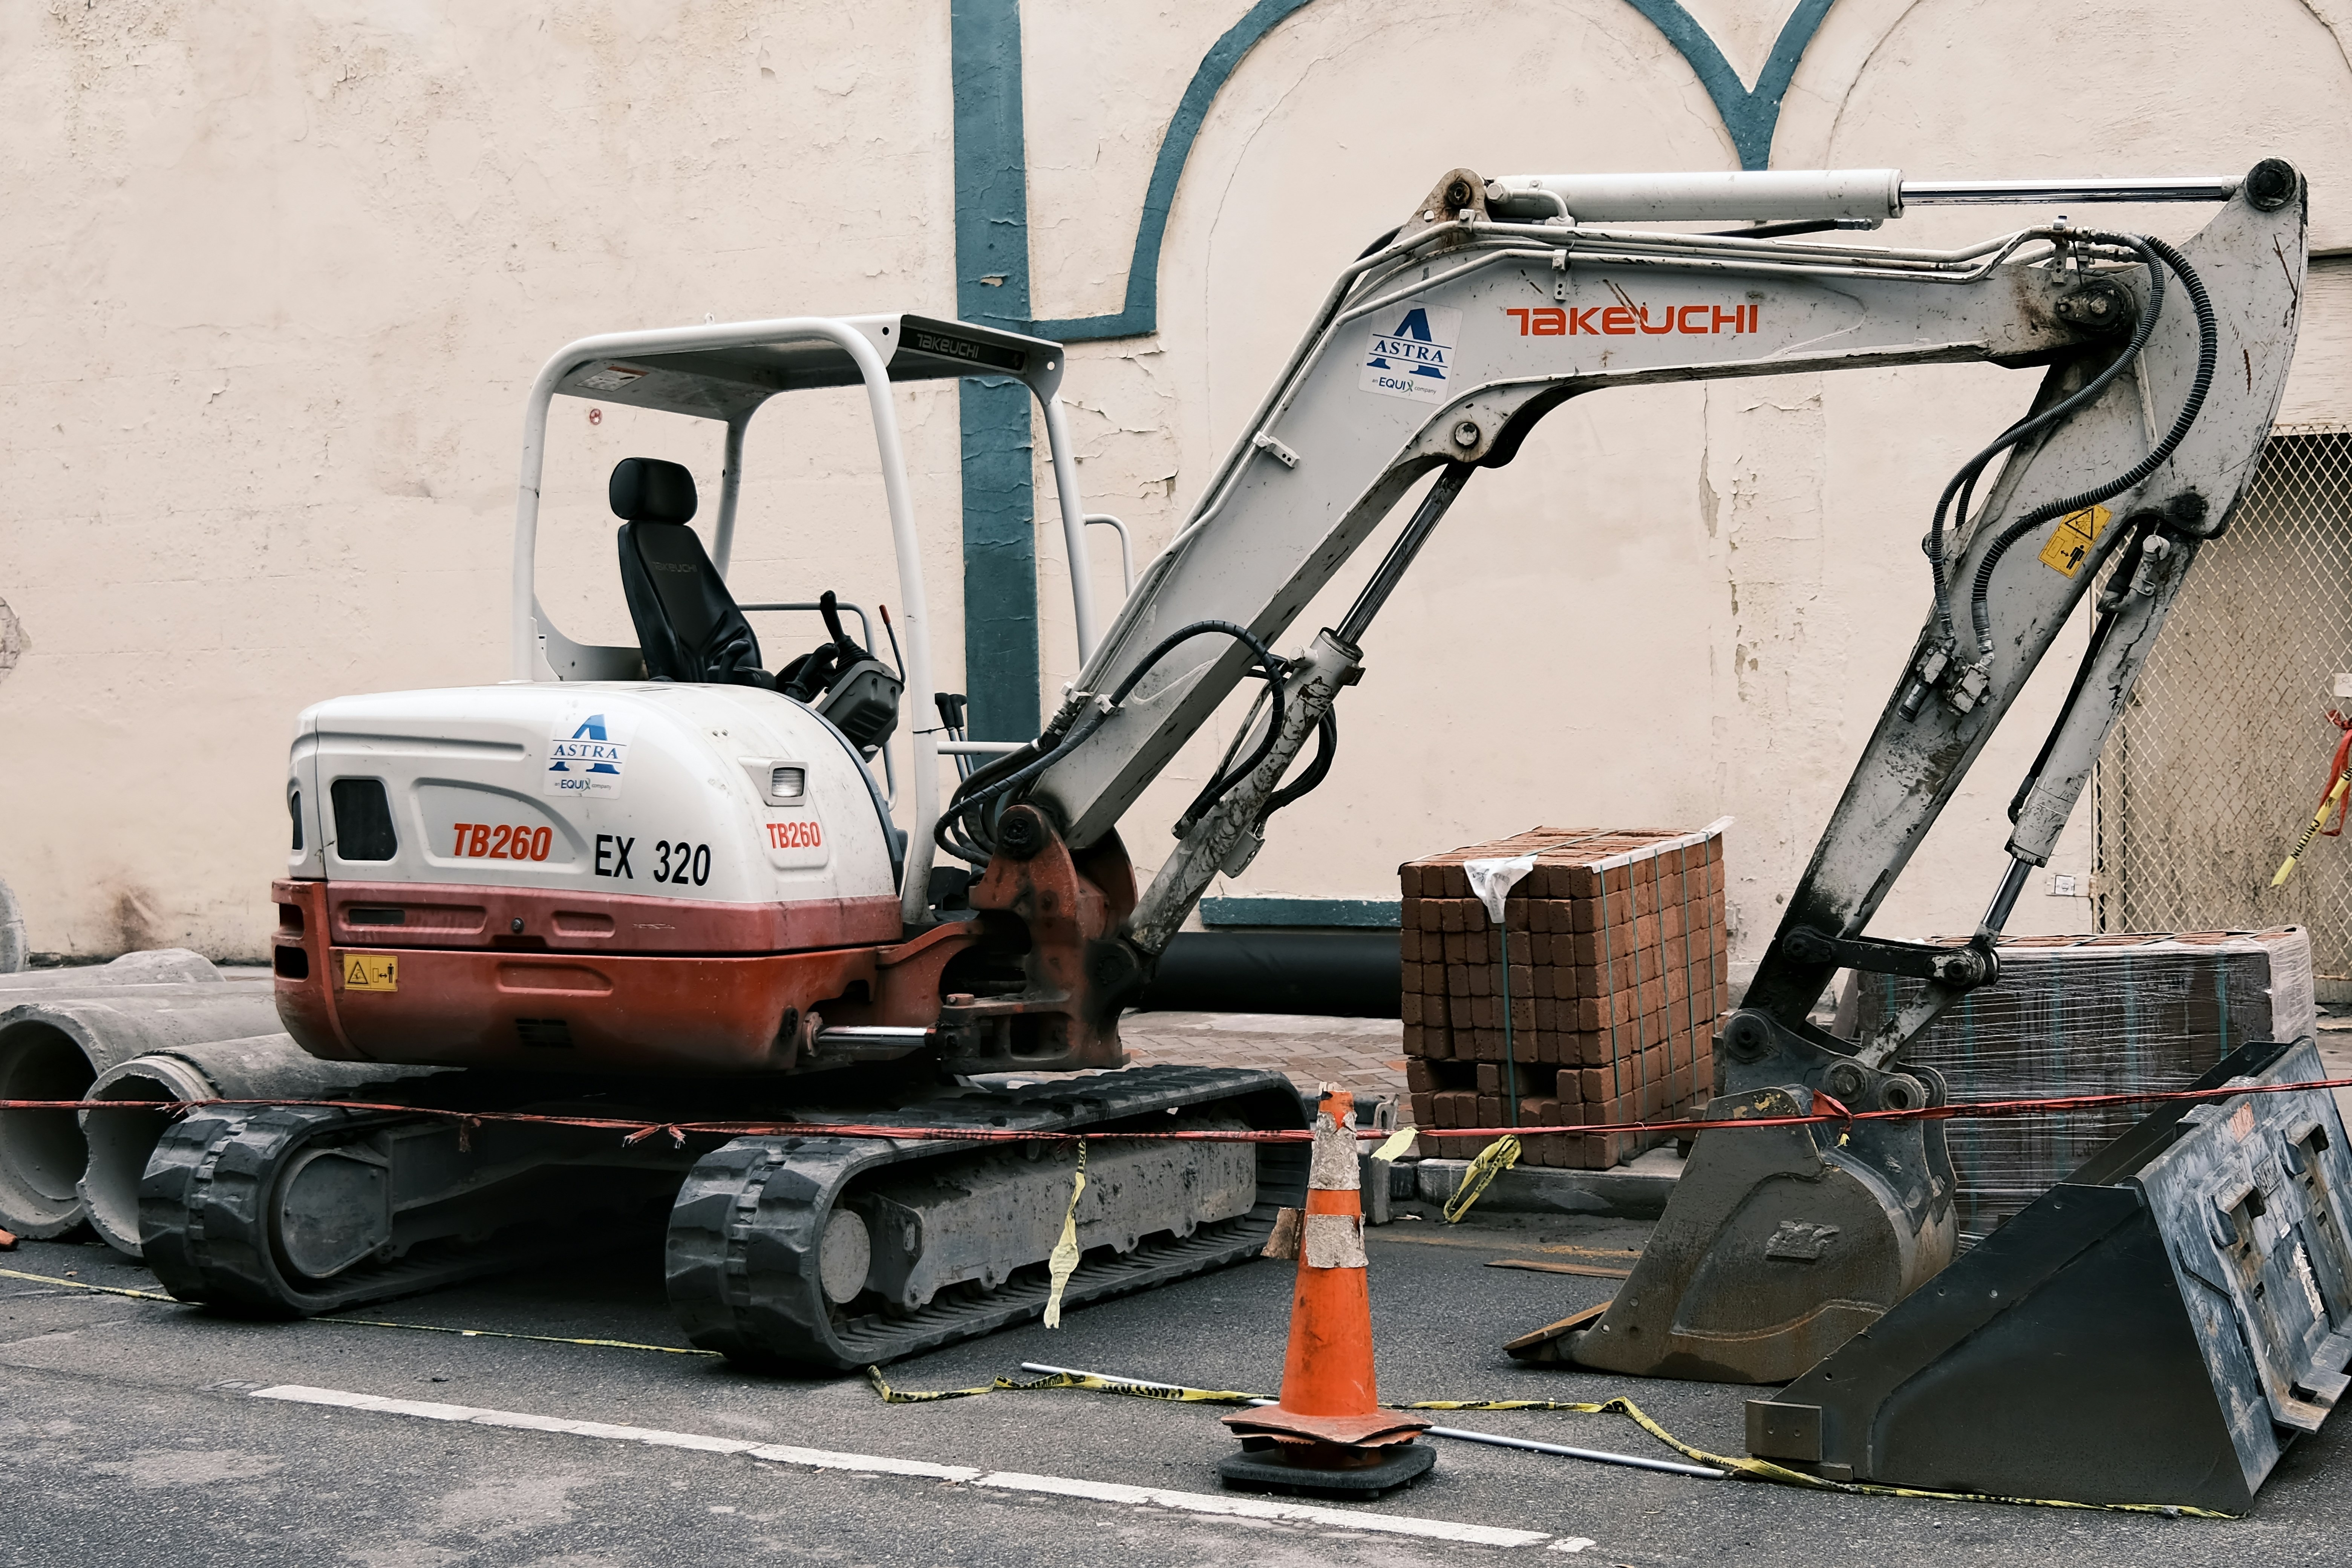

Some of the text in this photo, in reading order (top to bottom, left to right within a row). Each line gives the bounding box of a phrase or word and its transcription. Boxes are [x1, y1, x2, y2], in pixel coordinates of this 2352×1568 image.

[1507, 304, 1758, 336] TAKEUCHI
[917, 333, 980, 359] TAKEUCHI
[1373, 340, 1444, 363] ASTRA
[1414, 386, 1437, 395] company
[652, 561, 698, 573] TAKEUCHI
[553, 744, 618, 759] ASTRA
[453, 823, 553, 862] TB260
[766, 821, 822, 849] TB260
[595, 834, 712, 887] EX 320
